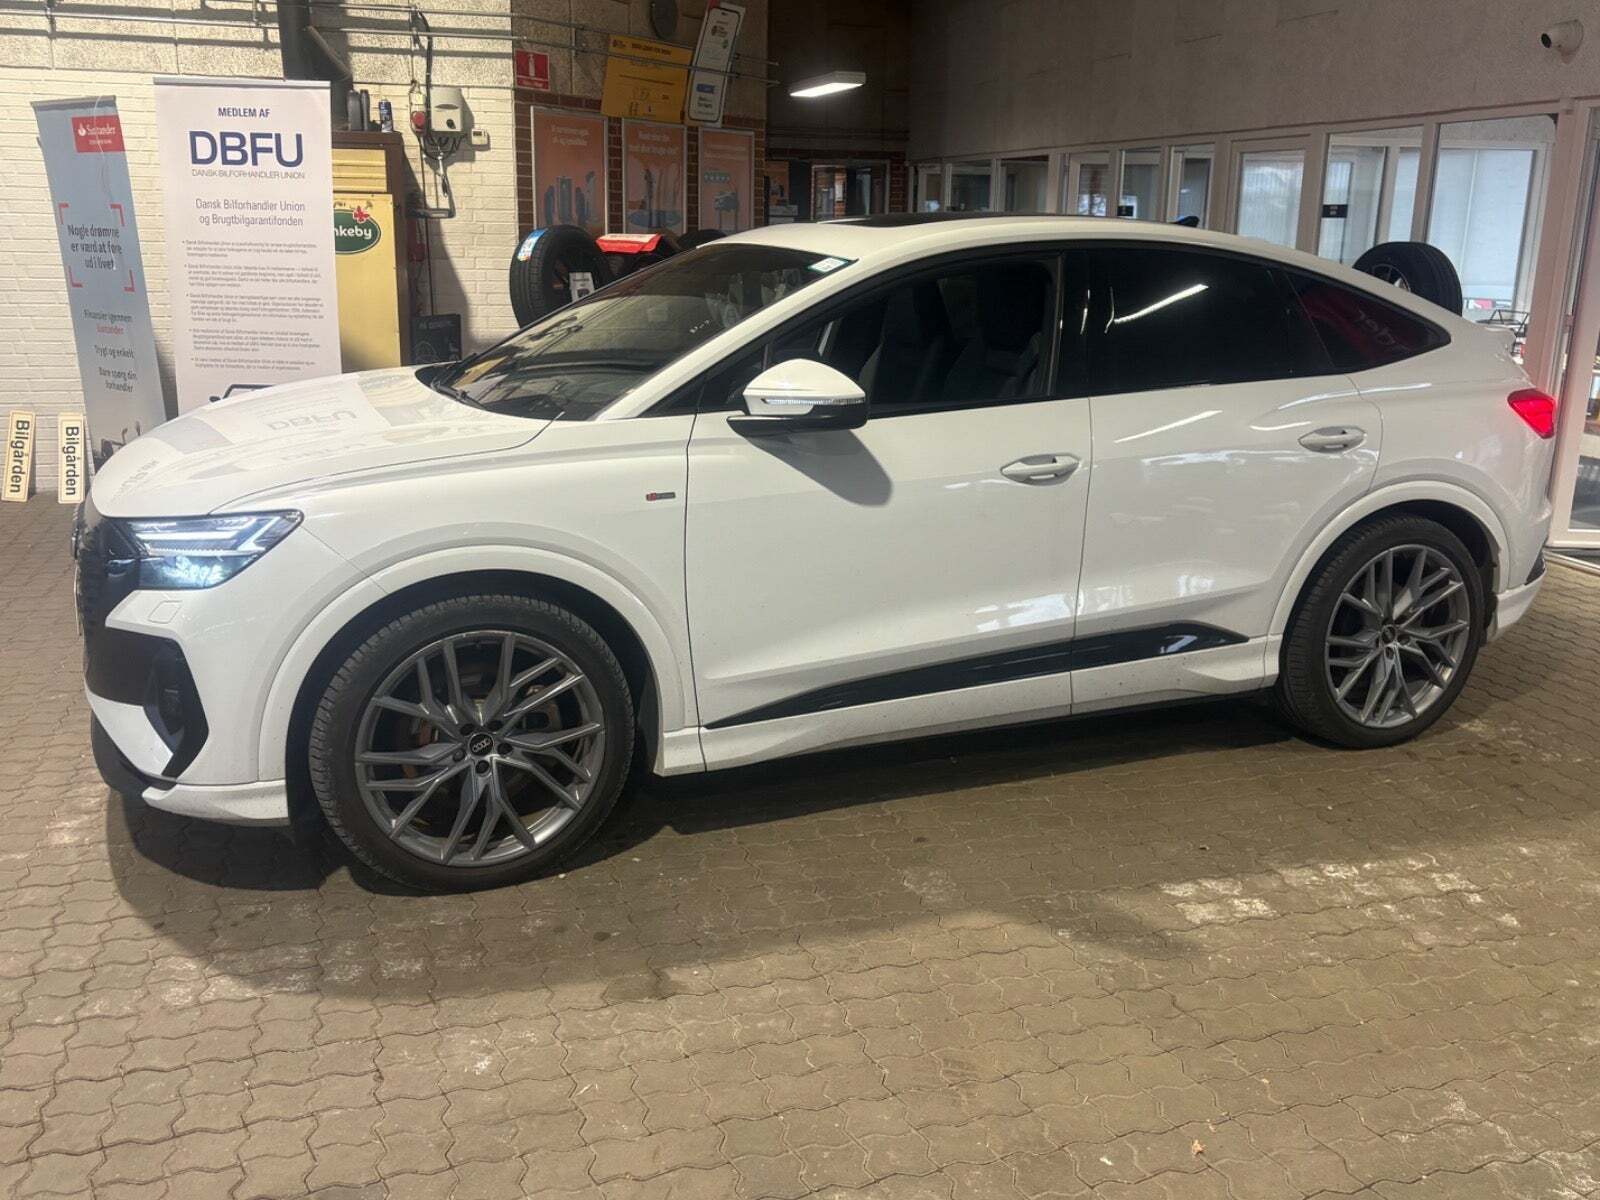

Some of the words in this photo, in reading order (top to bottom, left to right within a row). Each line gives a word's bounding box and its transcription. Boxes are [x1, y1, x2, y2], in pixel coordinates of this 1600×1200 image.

[218, 107, 257, 118] MEDLEM
[259, 108, 270, 118] AF
[86, 123, 116, 135] Santander
[189, 131, 303, 168] DBFU
[192, 169, 217, 178] DANSK
[218, 169, 280, 179] BILFORHANDLER
[281, 170, 305, 180] UNION
[195, 198, 221, 210] Dansk
[223, 199, 278, 211] Bilforhandler
[280, 201, 305, 212] Union
[199, 215, 210, 226] og
[212, 213, 303, 227] Brugtbilgarantifonden
[67, 224, 89, 240] Nogle
[71, 243, 79, 252] er
[81, 240, 98, 253] værd
[100, 243, 107, 254] at
[9, 420, 30, 493] Bilgården
[62, 426, 81, 496] Bilgården
